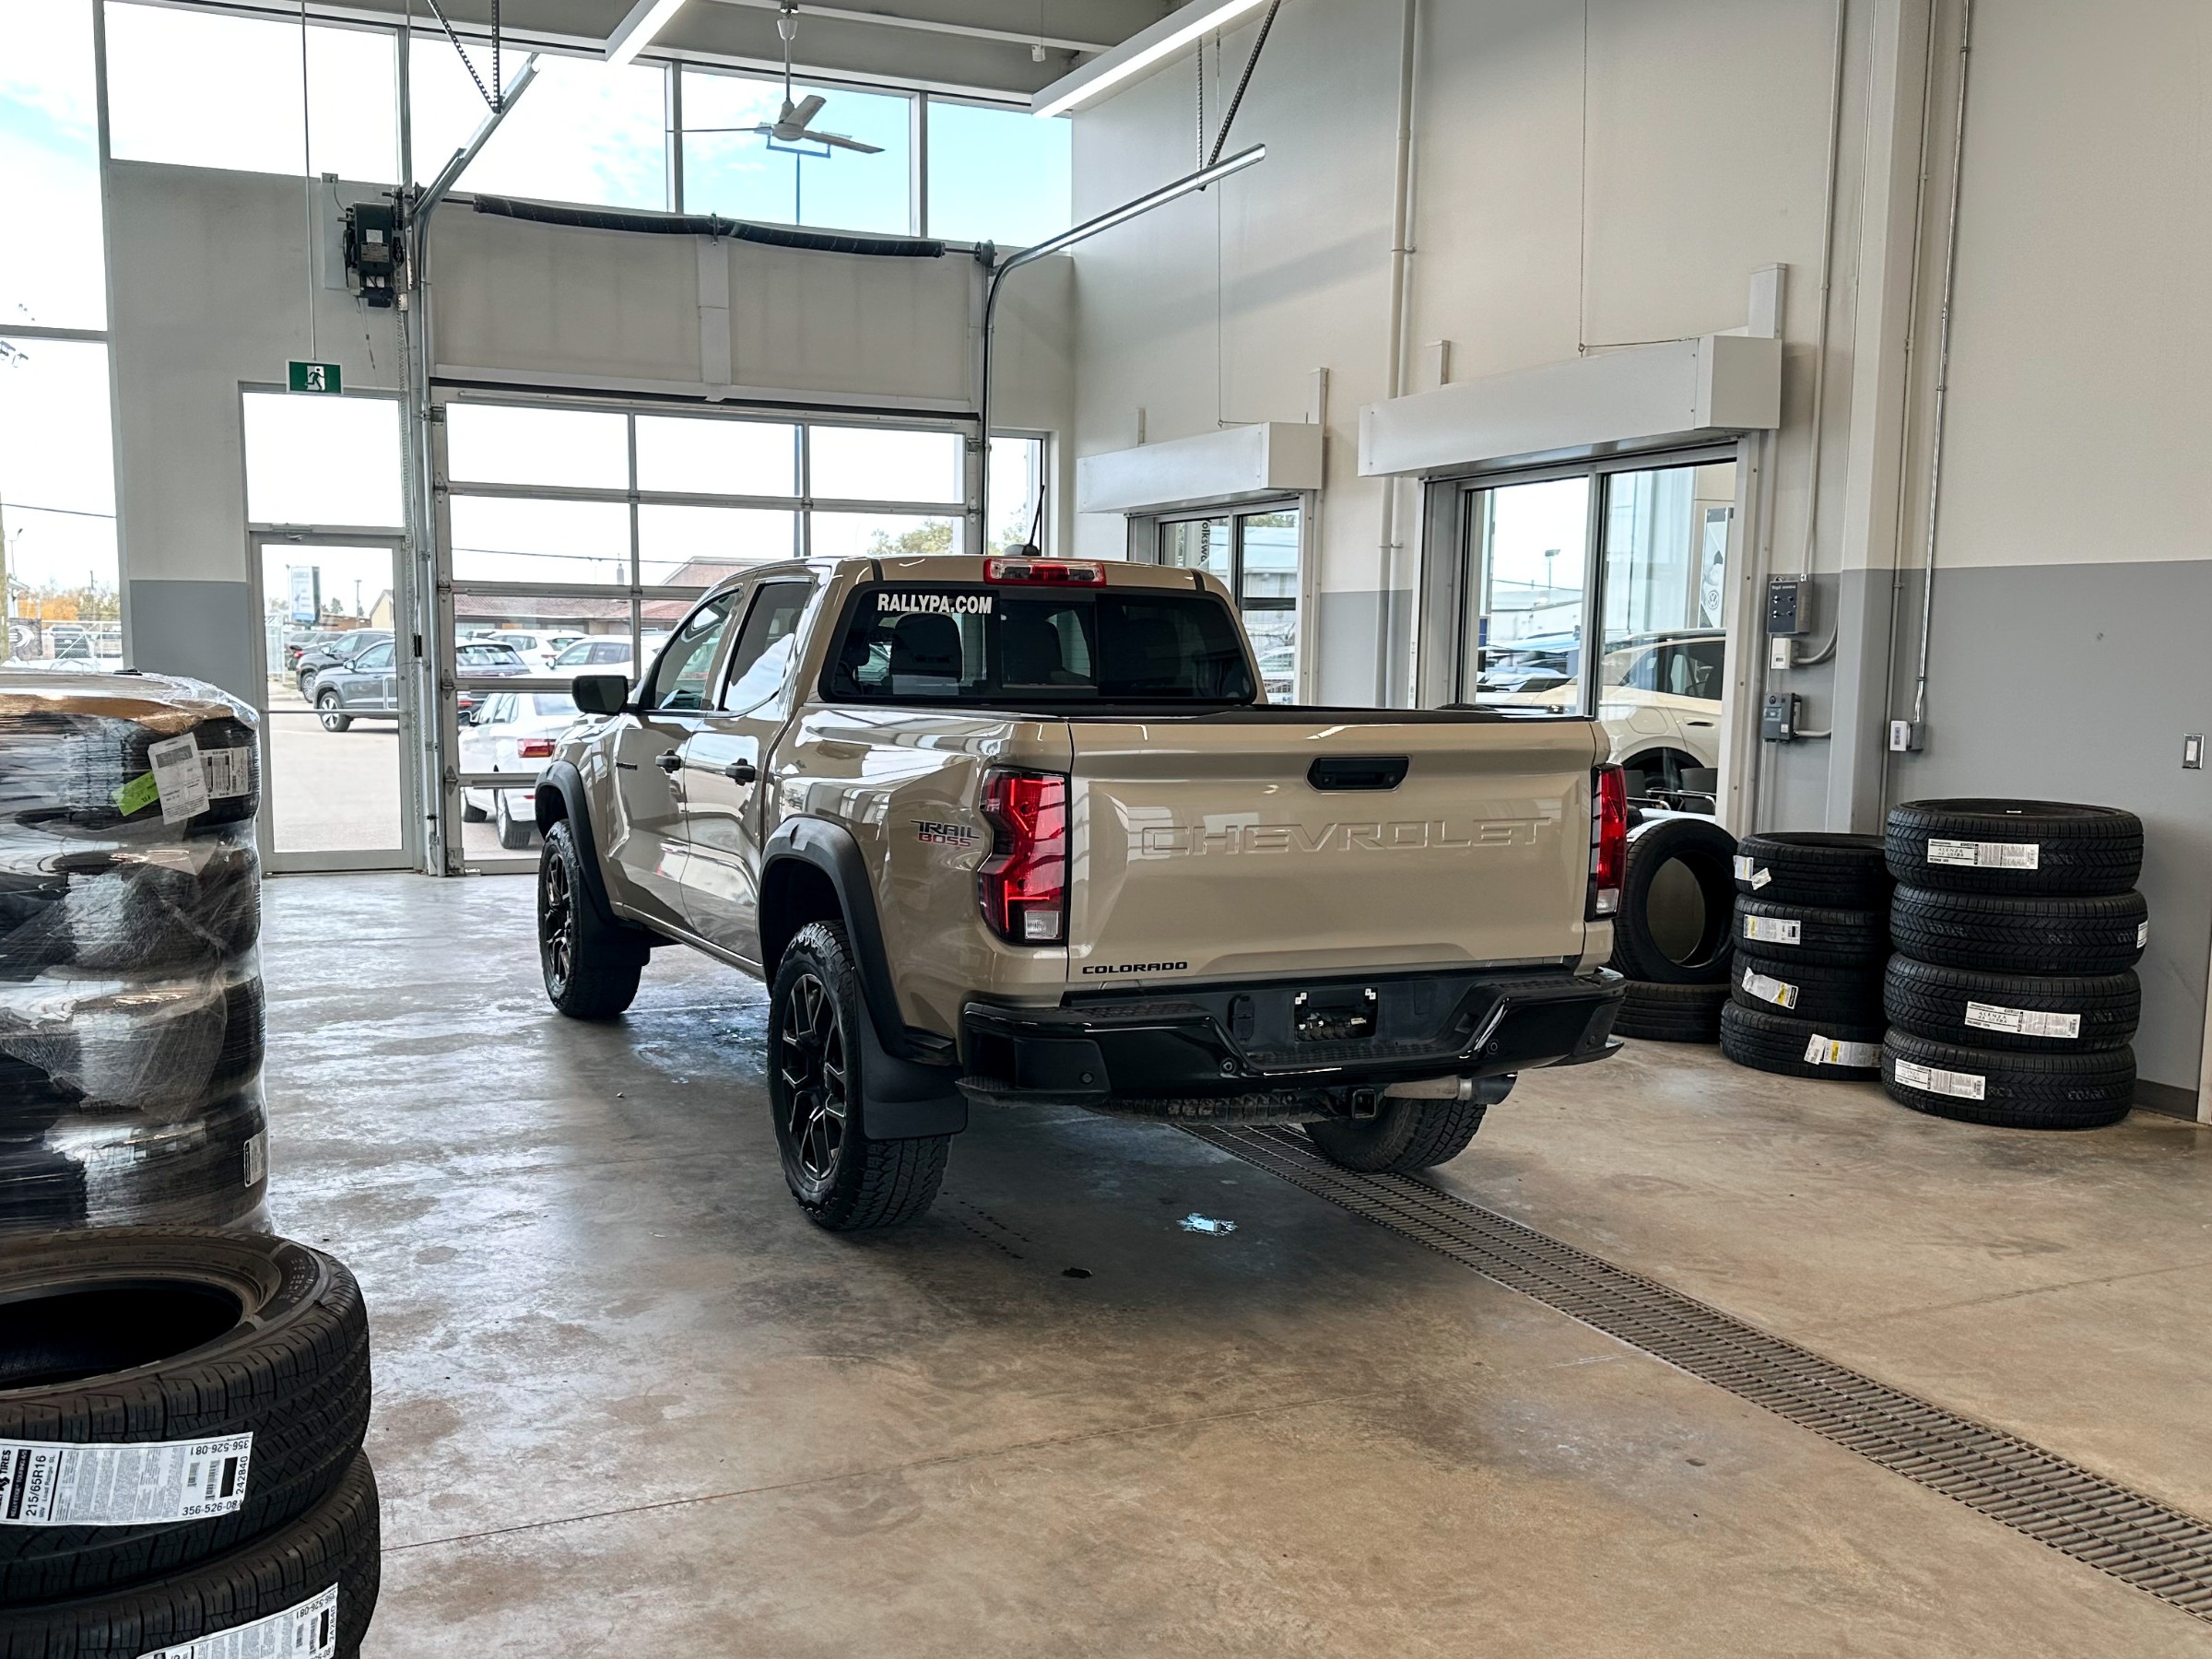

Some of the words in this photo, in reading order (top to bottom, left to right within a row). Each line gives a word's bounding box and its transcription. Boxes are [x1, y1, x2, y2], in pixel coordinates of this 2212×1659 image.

[1200, 518, 1211, 564] olkswa
[877, 593, 993, 614] RALLYPA.COM
[910, 819, 981, 840] TRAIL
[918, 832, 971, 848] BOSS
[1142, 817, 1553, 856] CHEVROLET
[1082, 961, 1188, 974] COLORADO
[191, 1440, 250, 1456] 356-526-081
[0, 1449, 11, 1475] TIRES
[26, 1454, 46, 1516] 215/65R16
[236, 1456, 249, 1495] 242840
